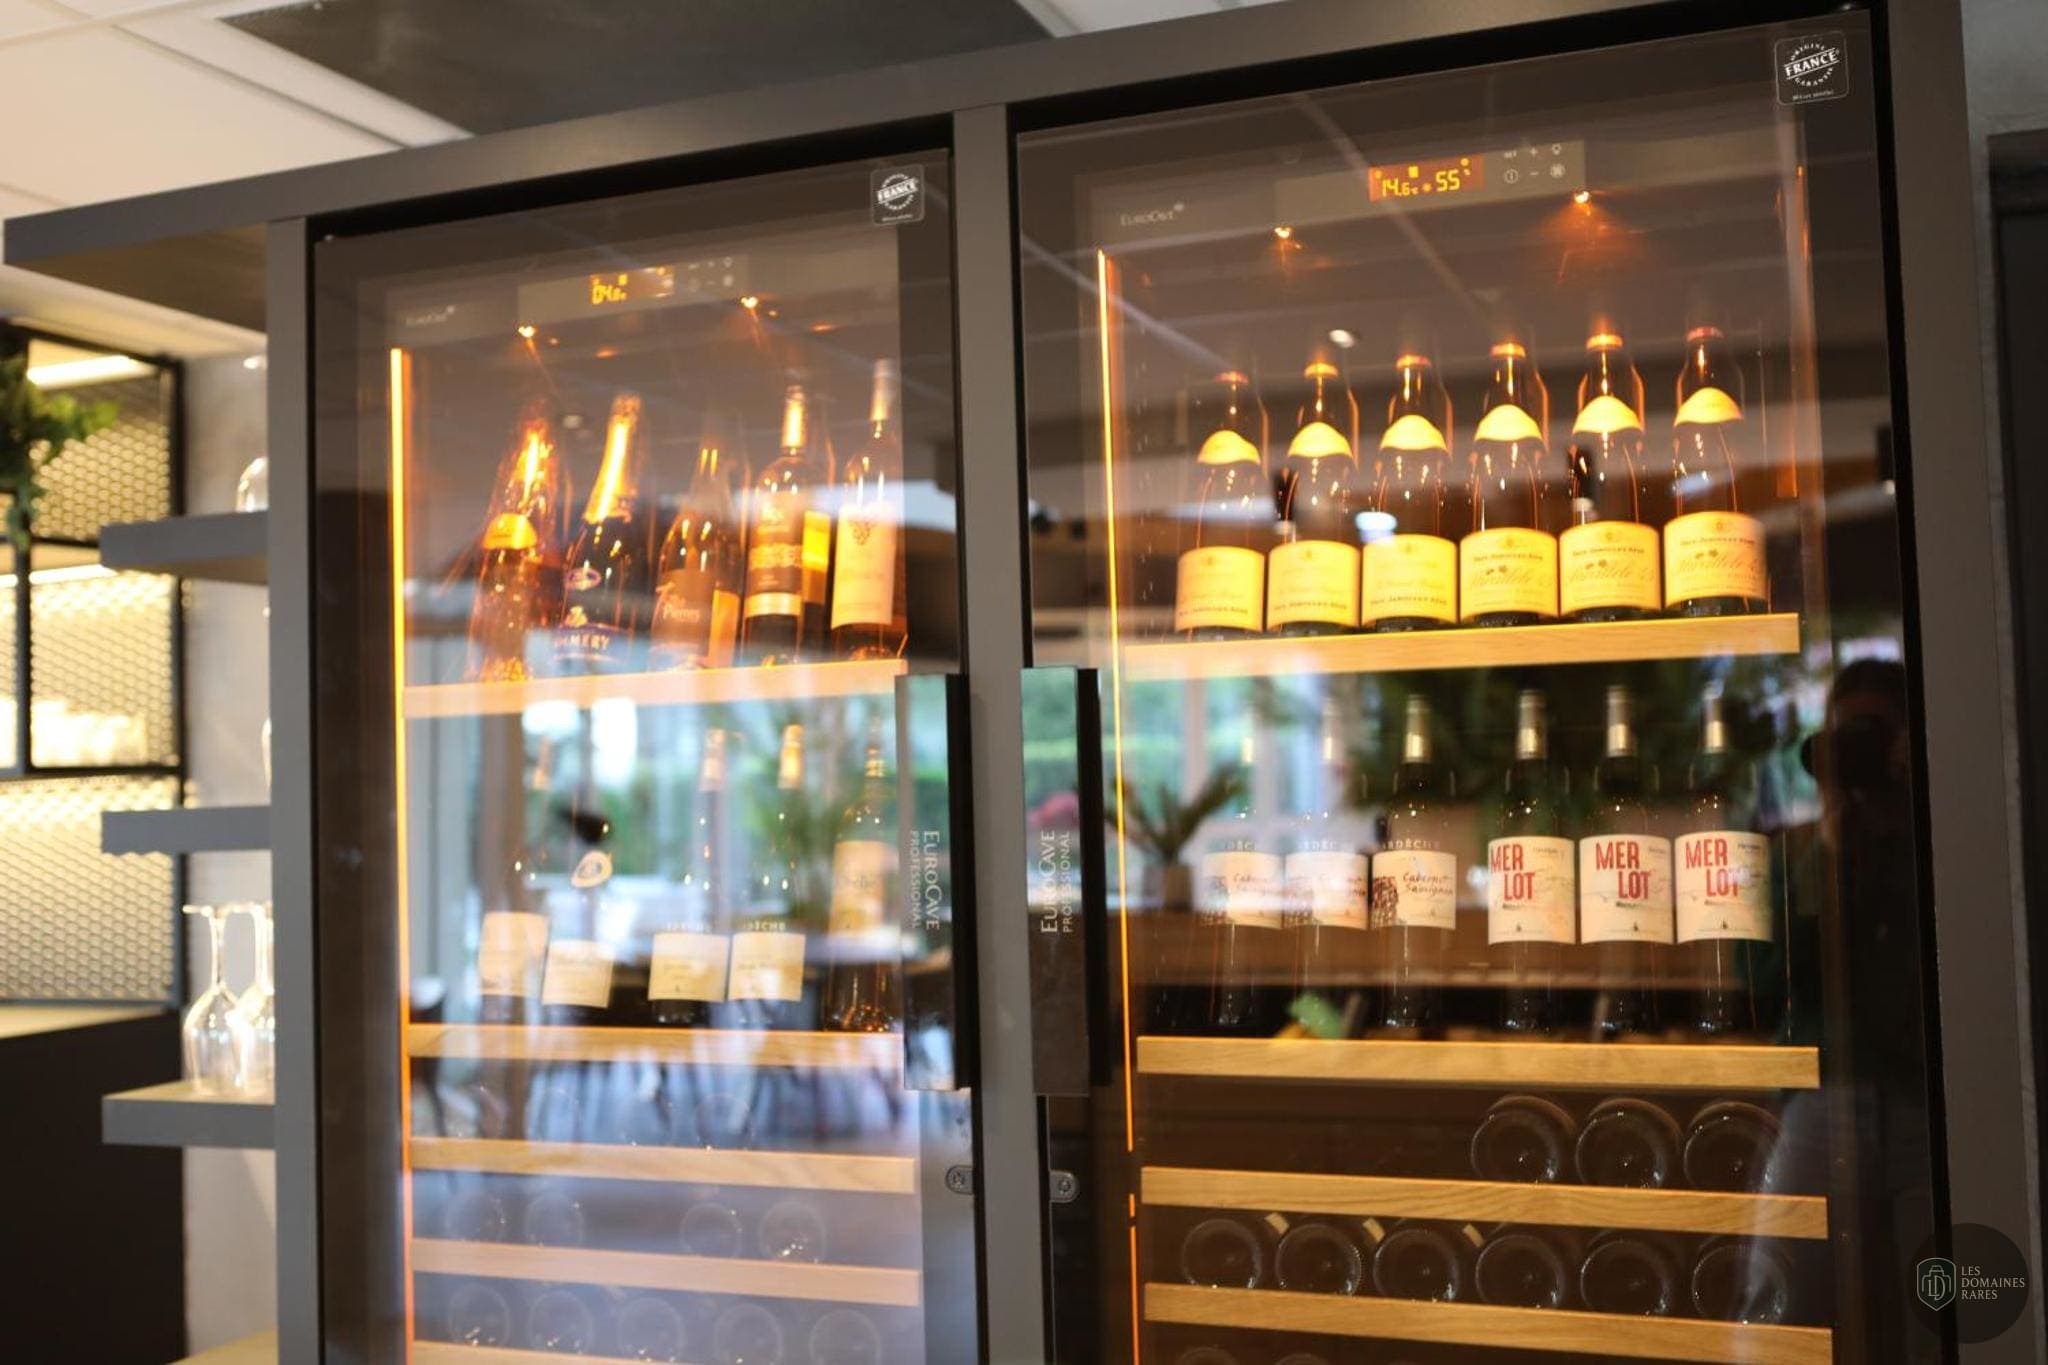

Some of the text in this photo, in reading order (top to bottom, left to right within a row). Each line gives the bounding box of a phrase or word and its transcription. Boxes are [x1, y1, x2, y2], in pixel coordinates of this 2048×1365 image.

[1785, 50, 1838, 77] FRANCE
[1490, 843, 1525, 873] MER
[1595, 841, 1640, 870] MER
[1685, 838, 1728, 869] MER
[910, 830, 922, 929] PROFESSIONAL
[1059, 831, 1073, 933] PROFESSIONAL
[1504, 872, 1536, 901] LOT
[1618, 870, 1650, 900] LOT
[1706, 868, 1742, 897] LOT
